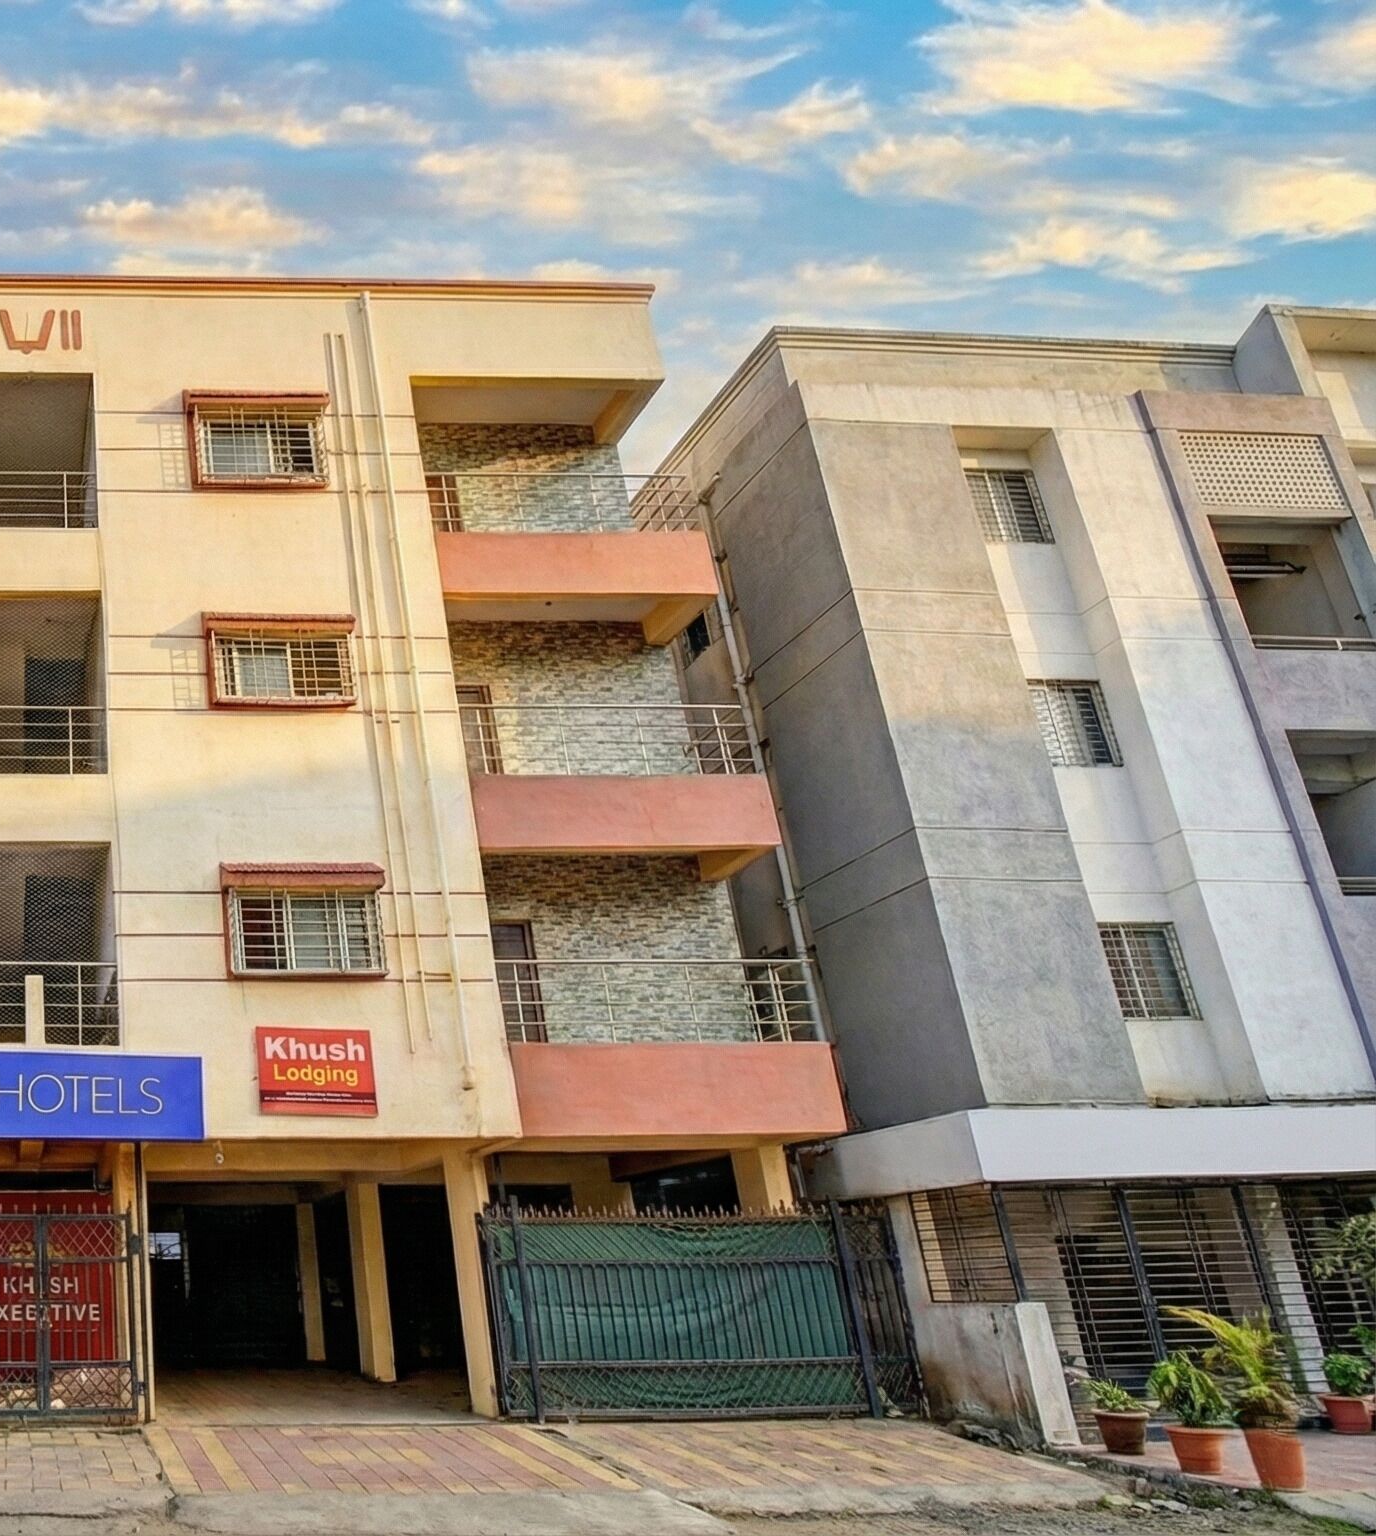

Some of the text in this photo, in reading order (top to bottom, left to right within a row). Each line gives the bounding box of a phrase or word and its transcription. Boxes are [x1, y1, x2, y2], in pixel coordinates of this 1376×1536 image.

[264, 1036, 366, 1061] Khush
[273, 1063, 359, 1087] Lodging
[3, 1276, 79, 1294] KHSH
